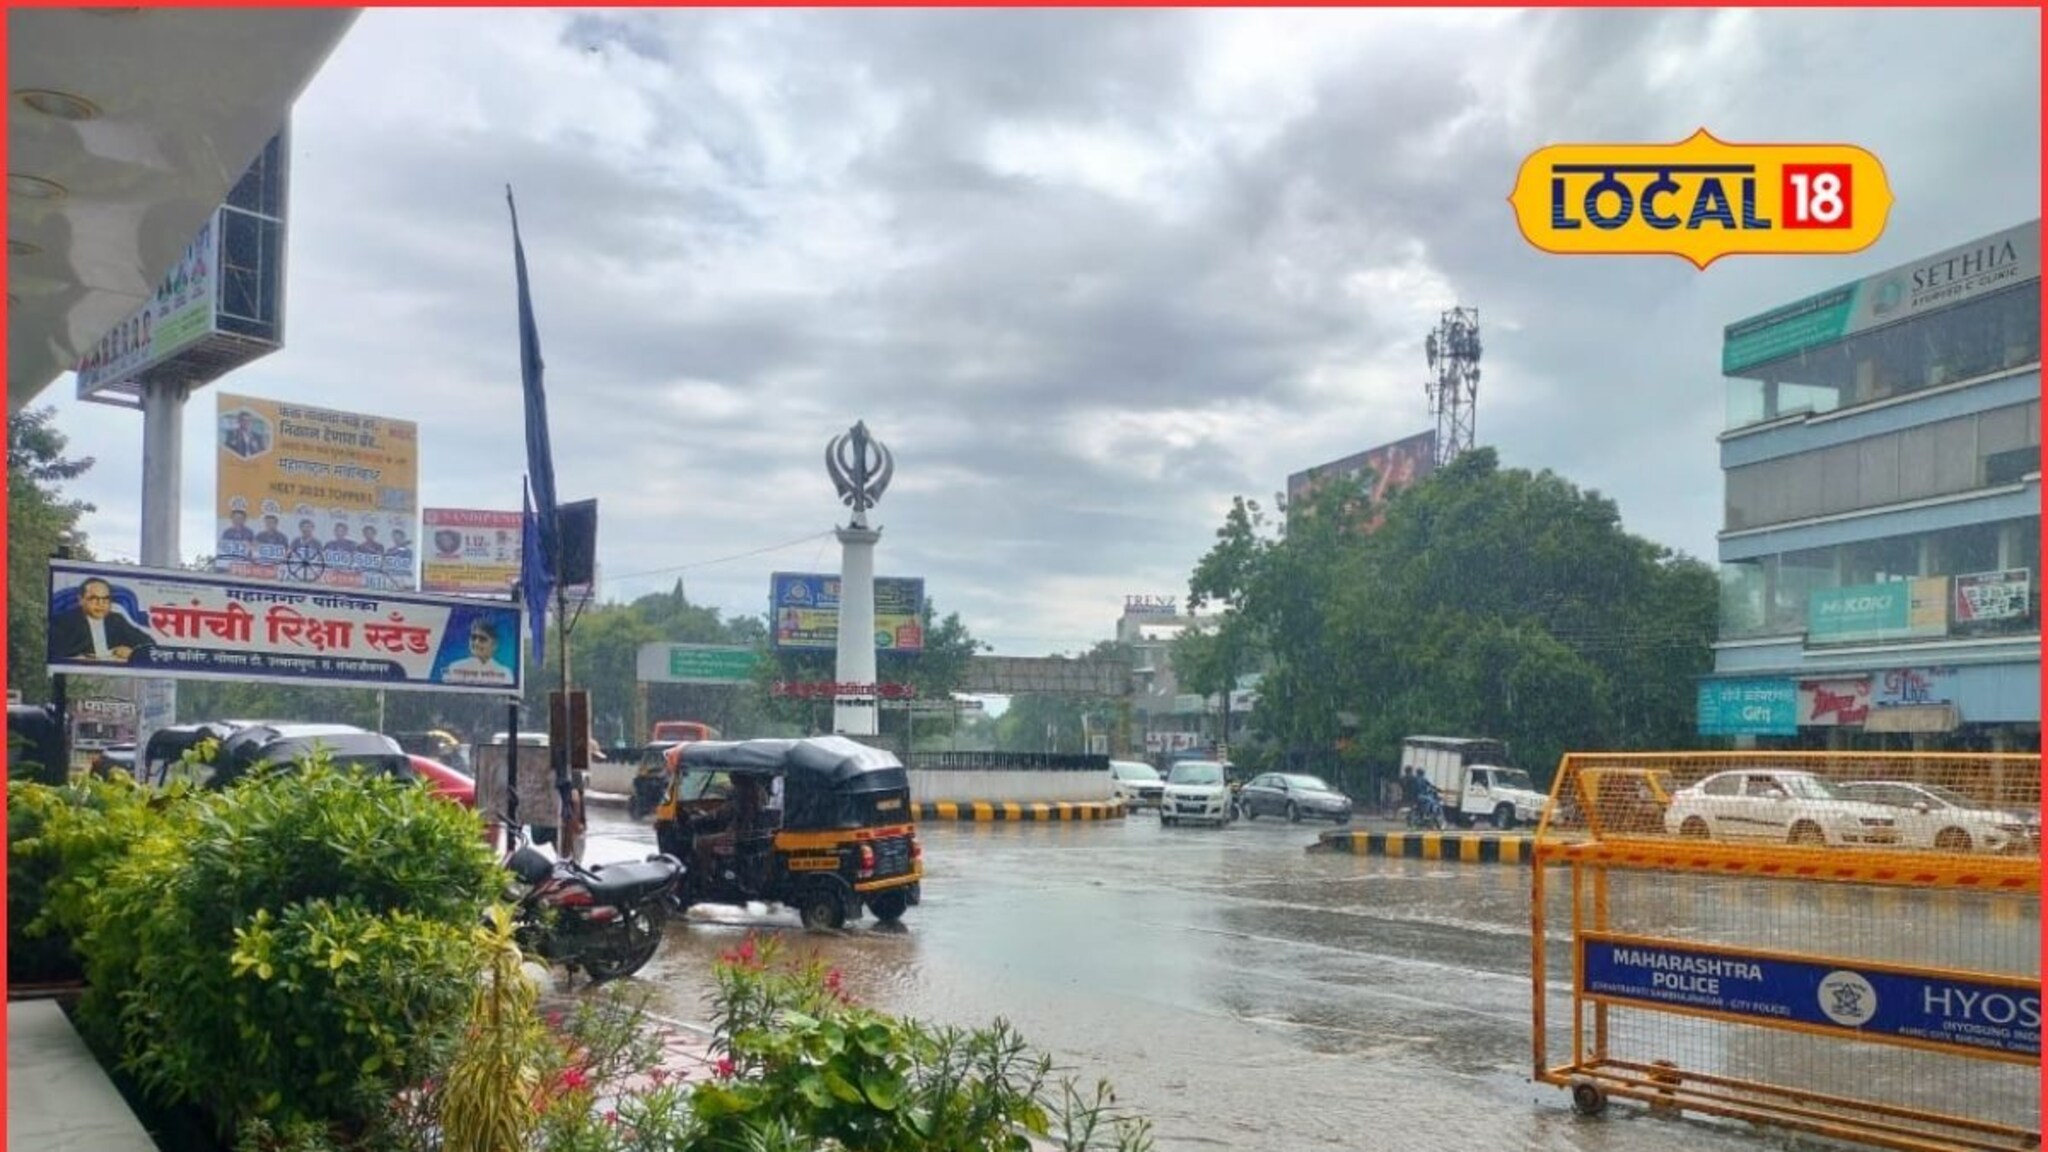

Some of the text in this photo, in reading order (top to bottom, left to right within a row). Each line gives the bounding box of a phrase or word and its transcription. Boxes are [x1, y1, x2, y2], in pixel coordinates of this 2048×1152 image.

[1912, 239, 2018, 290] SETHIA
[226, 588, 306, 606] महानगर
[312, 593, 380, 613] पालिका
[150, 597, 432, 655] सांची रिक्षा स्टँड
[1613, 949, 1763, 982] MAHARASHTRA
[1652, 971, 1720, 995] POLICE
